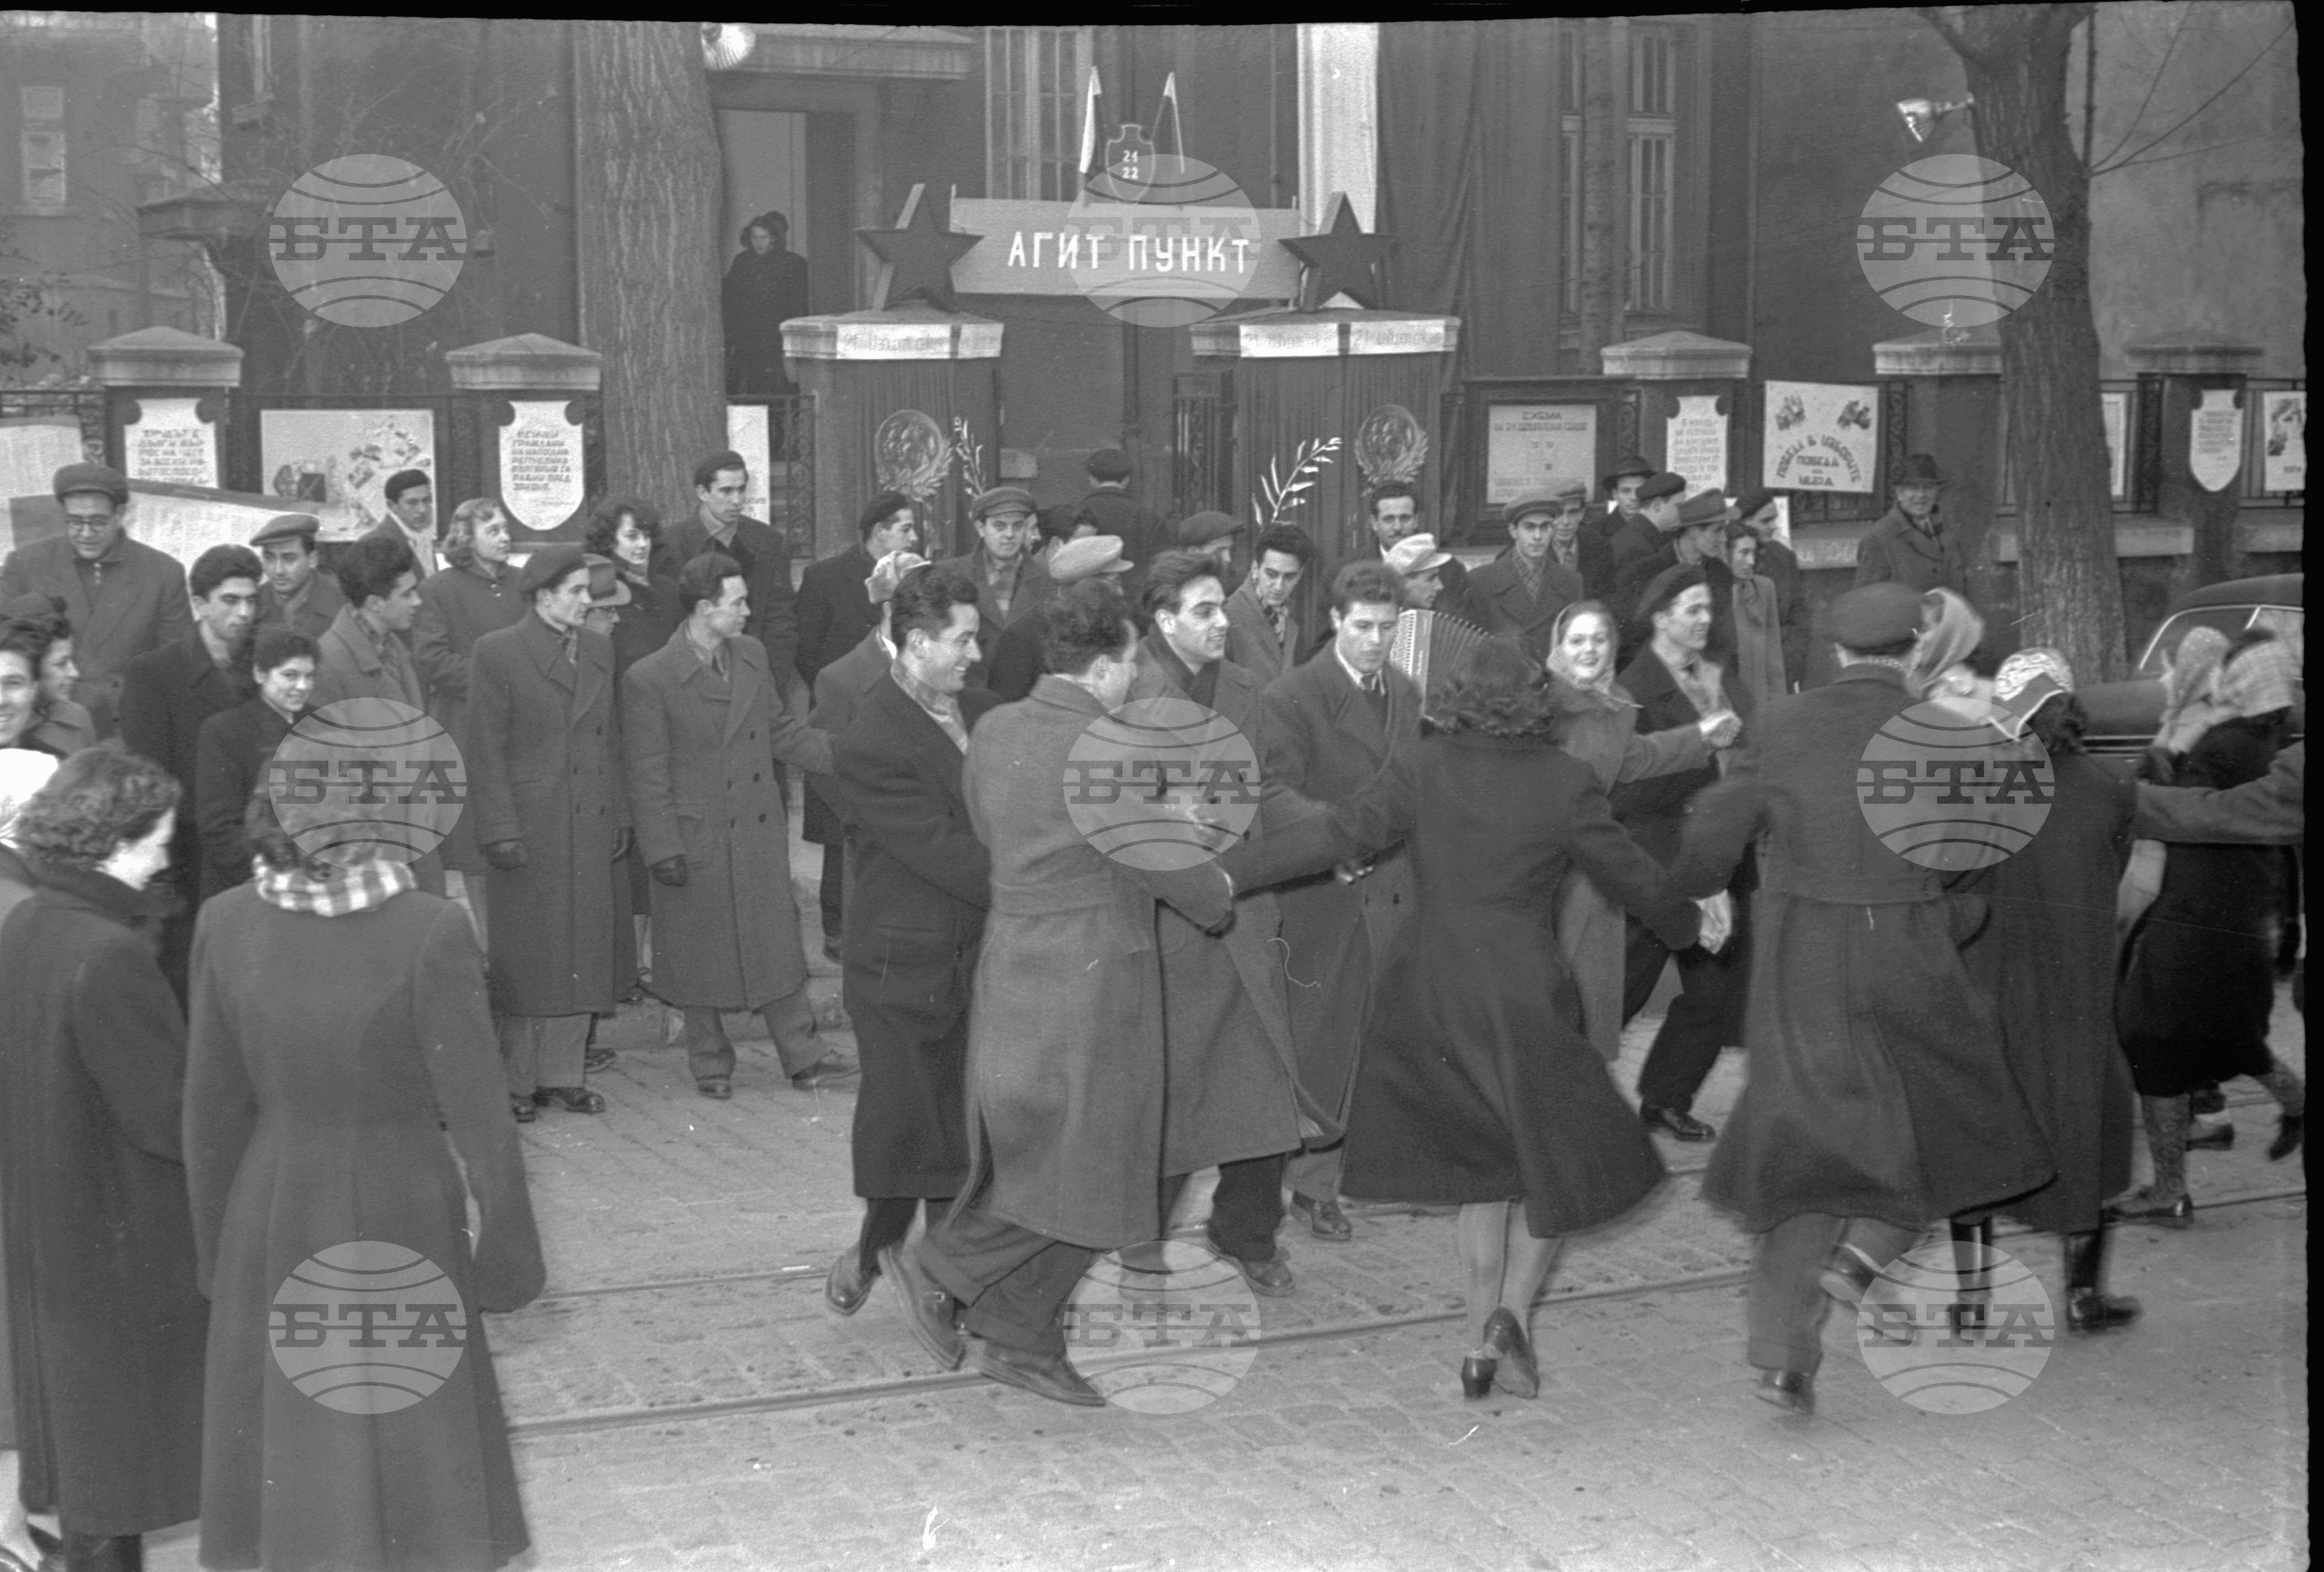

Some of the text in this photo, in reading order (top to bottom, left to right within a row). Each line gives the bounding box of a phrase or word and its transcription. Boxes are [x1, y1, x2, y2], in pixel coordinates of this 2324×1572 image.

[1122, 149, 1139, 163] 24
[1122, 166, 1139, 179] 22
[1007, 231, 1249, 274] АГИТ ПУНКТ
